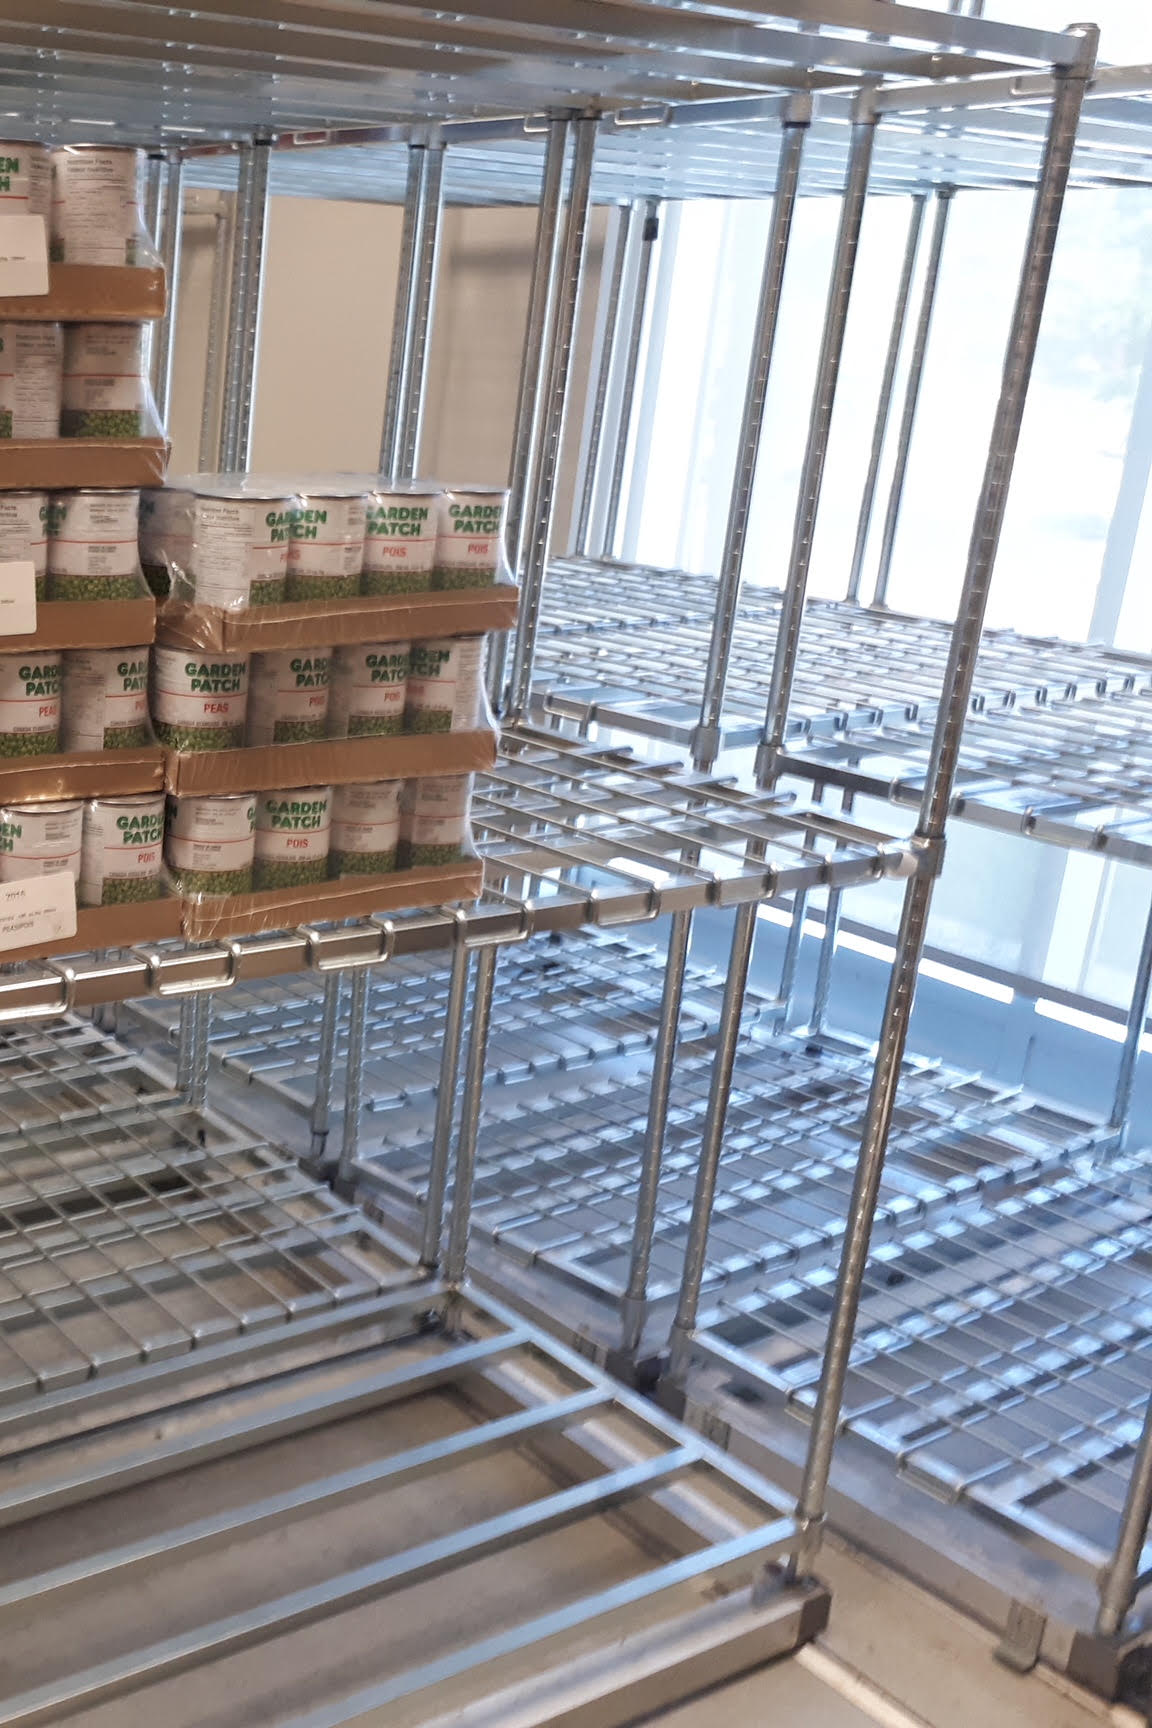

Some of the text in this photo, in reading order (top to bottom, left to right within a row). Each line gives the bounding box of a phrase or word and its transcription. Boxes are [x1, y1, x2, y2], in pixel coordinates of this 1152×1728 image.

[368, 521, 421, 537] PATCH
[383, 546, 407, 558] POIS
[468, 543, 489, 555] POIS
[117, 662, 147, 677] GAR
[185, 663, 247, 678] GARDEN
[290, 658, 329, 673] GARD
[19, 665, 57, 681] GARD
[372, 669, 406, 682] PATC
[124, 677, 147, 691] PAT
[191, 679, 241, 692] PATCH
[296, 674, 329, 687] PATC
[26, 681, 59, 696] PATC
[204, 703, 229, 713] PEAS
[265, 800, 327, 815] GARDEN
[272, 815, 321, 829] PATCH
[286, 838, 309, 848] POIS
